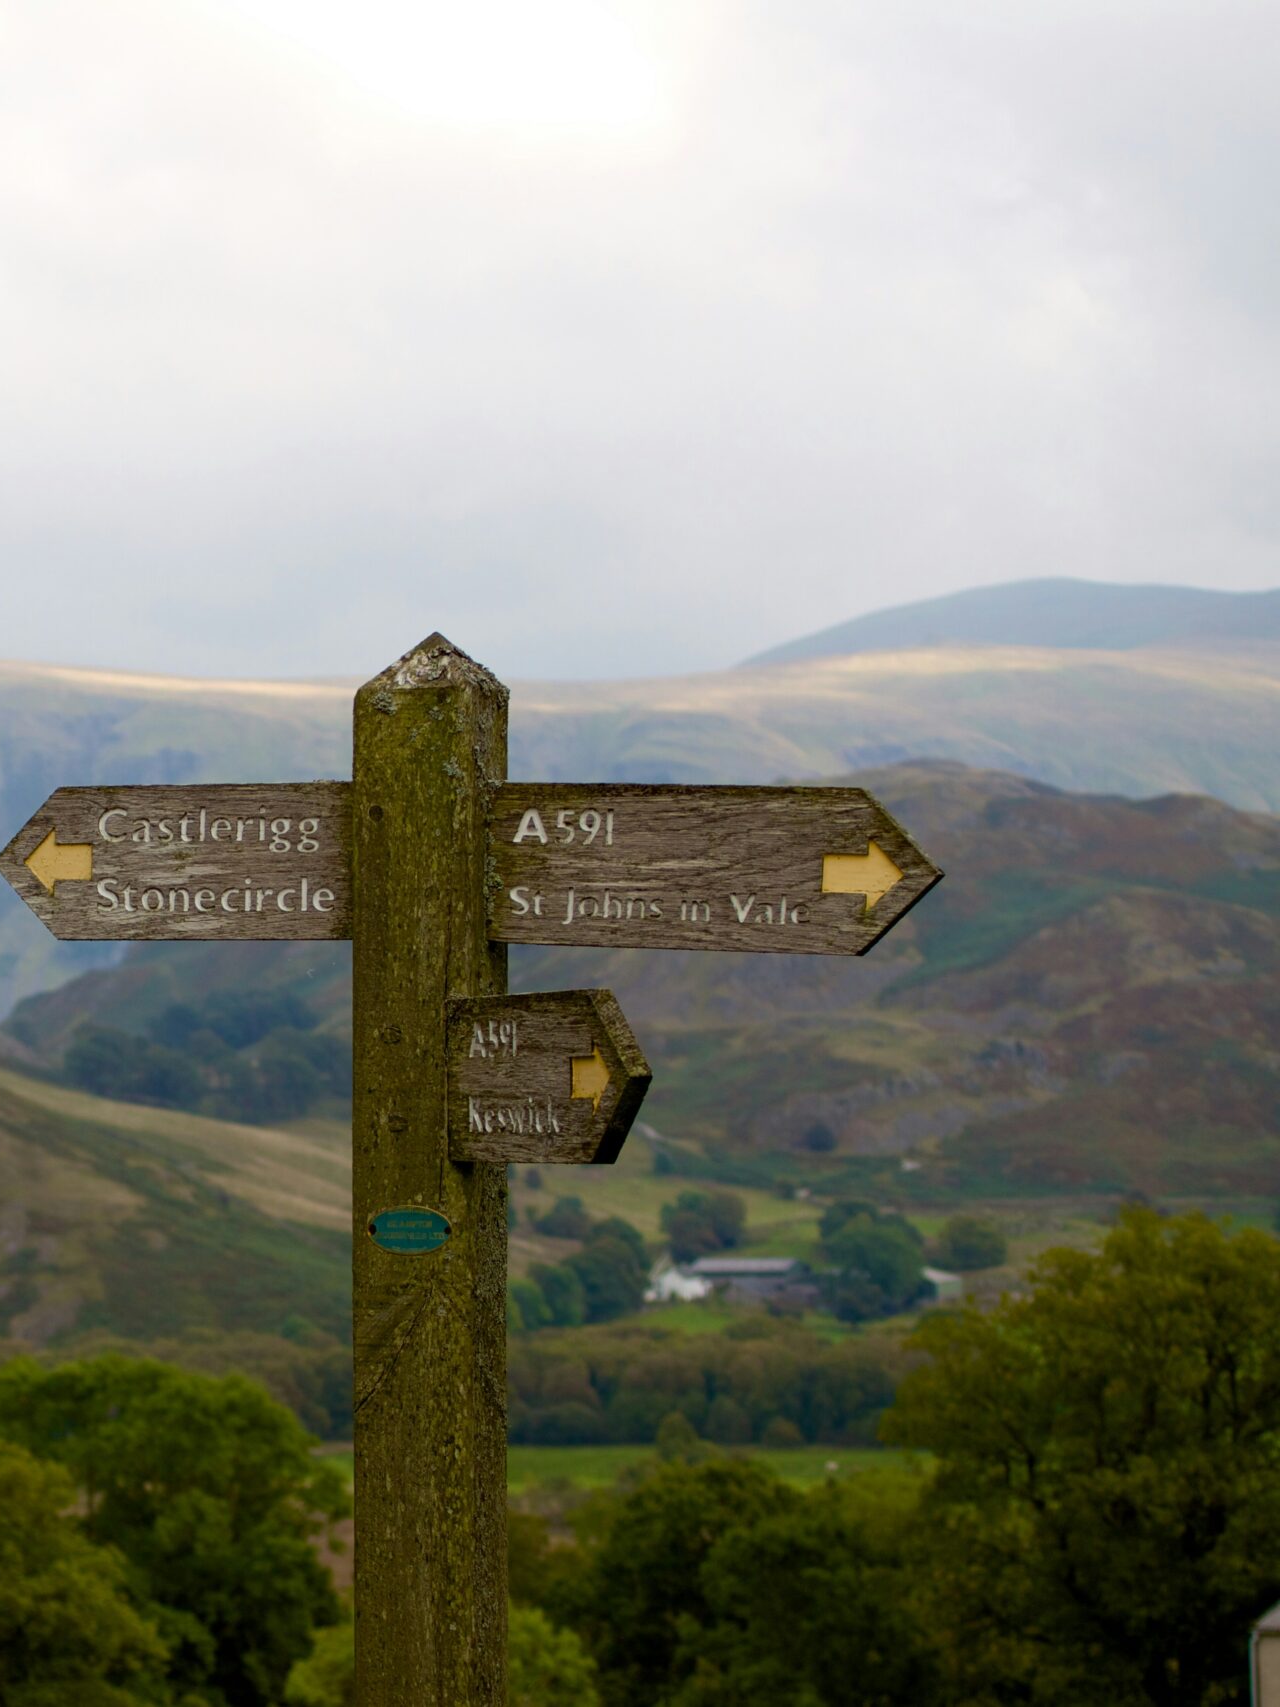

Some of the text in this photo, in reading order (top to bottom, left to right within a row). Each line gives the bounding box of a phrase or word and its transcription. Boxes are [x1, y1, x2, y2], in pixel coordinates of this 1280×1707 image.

[98, 807, 320, 853] Castlerigg
[96, 878, 335, 912] Stonecircle
[509, 886, 811, 925] St Johns in Vale
[469, 1021, 517, 1058] A591
[468, 1095, 560, 1133] Keswick
